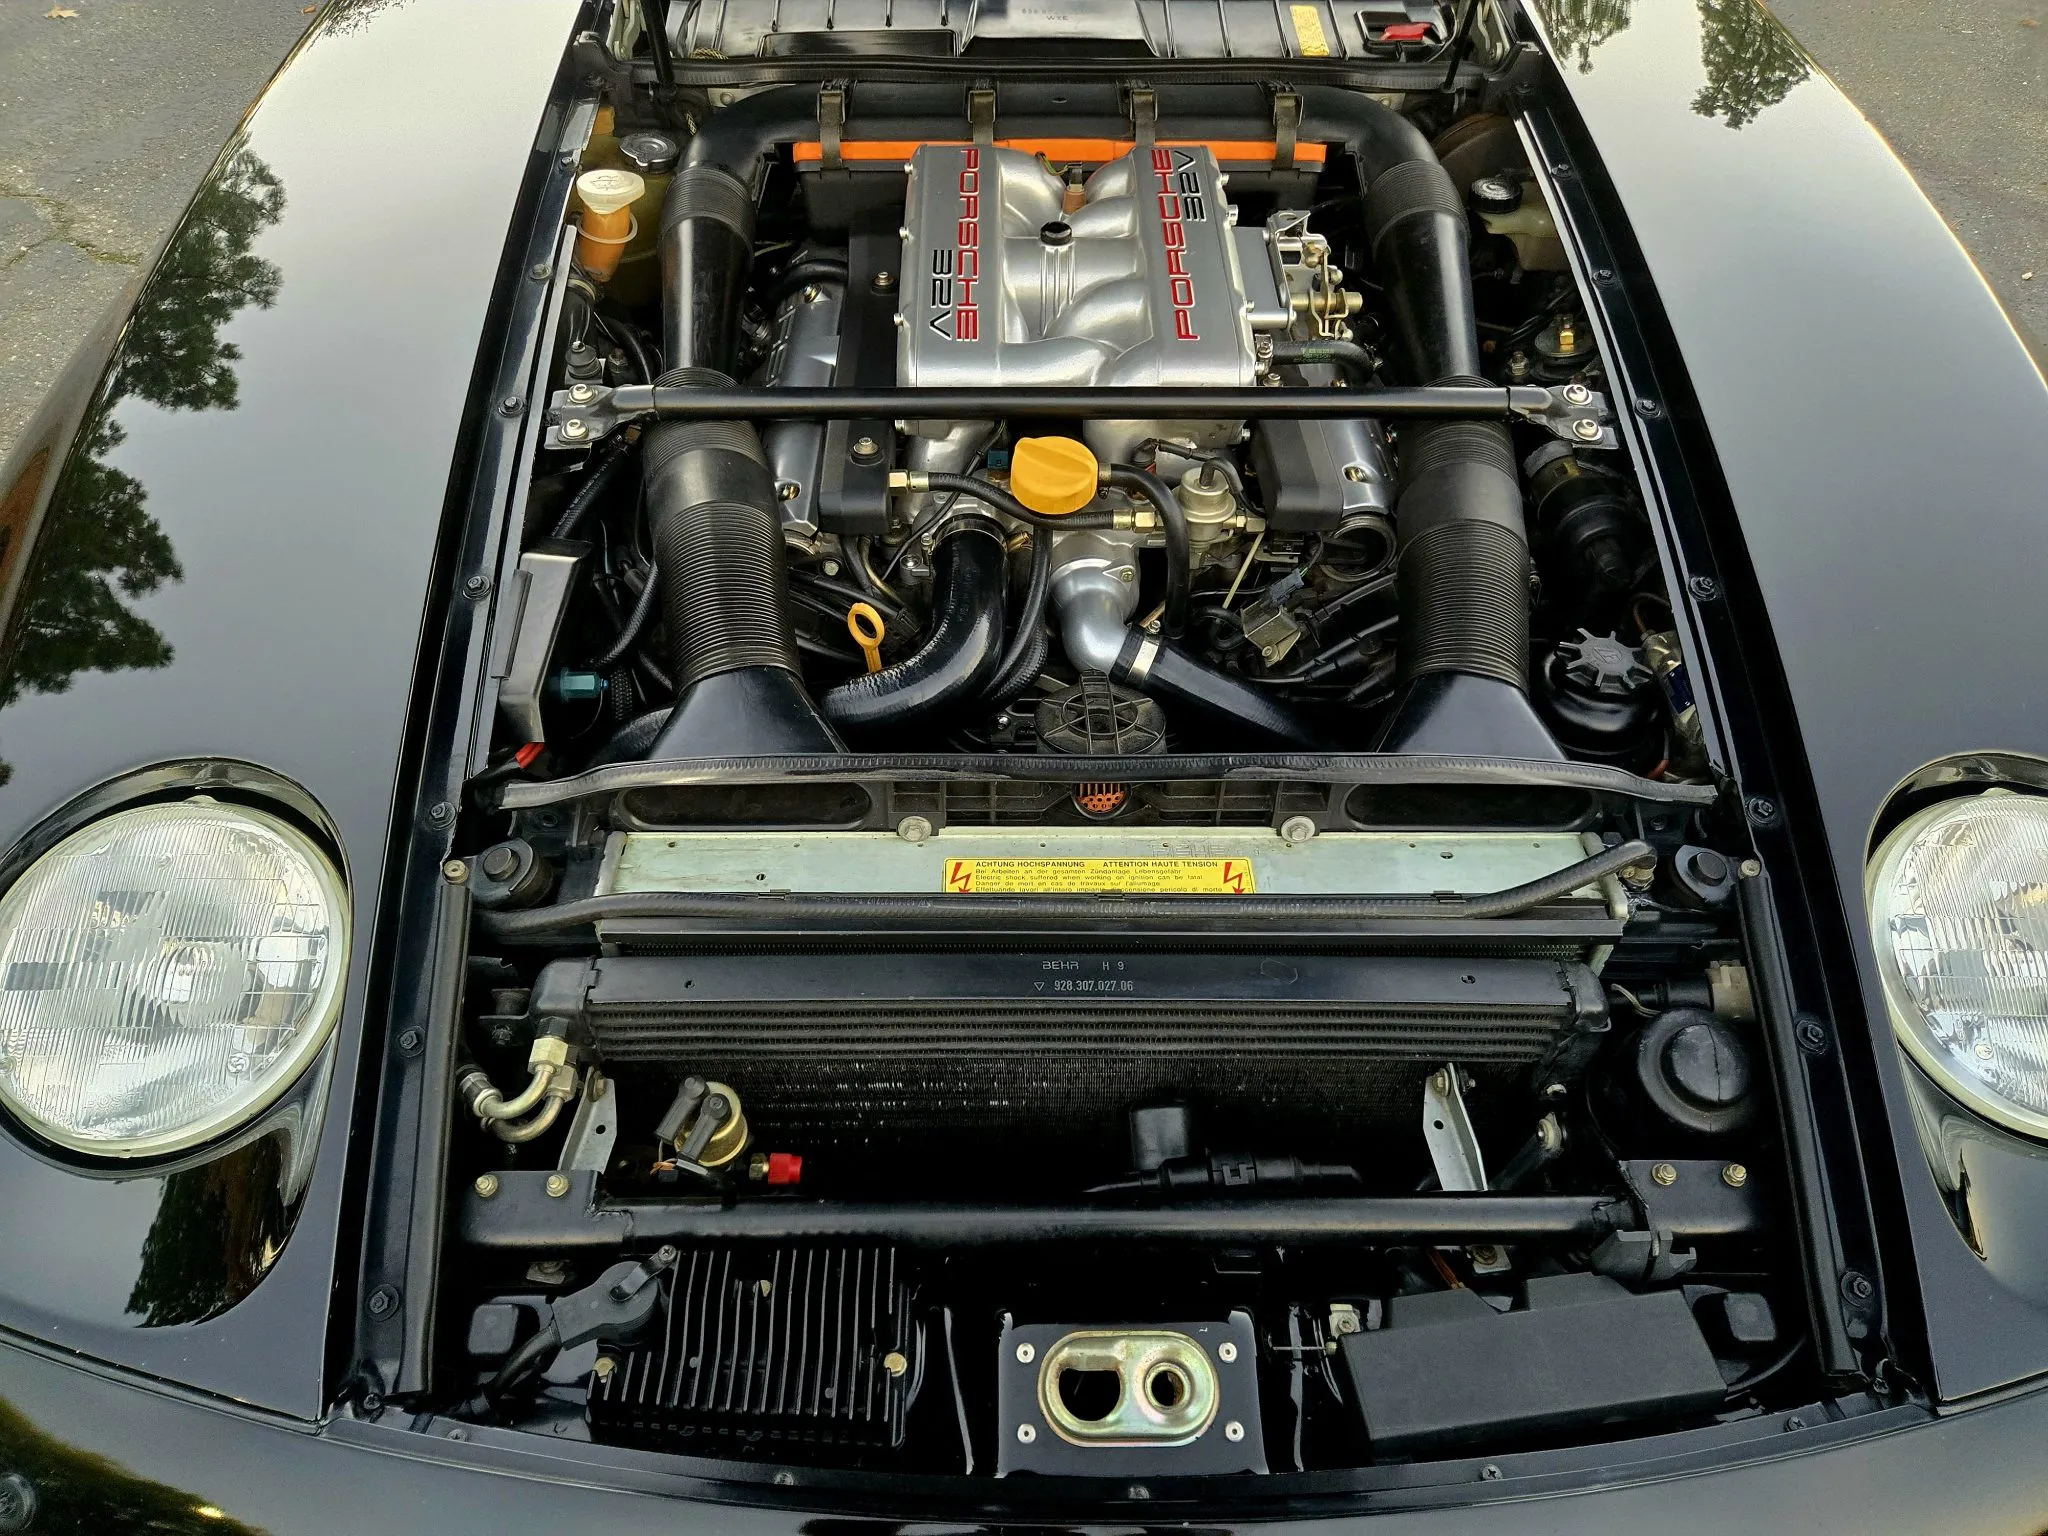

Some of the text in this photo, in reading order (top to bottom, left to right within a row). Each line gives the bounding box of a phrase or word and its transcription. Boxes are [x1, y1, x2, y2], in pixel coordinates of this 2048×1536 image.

[1174, 150, 1206, 222] 32V
[956, 148, 979, 342] PORSCHE
[1151, 149, 1200, 341] PORSCHE
[929, 249, 952, 341] 32V
[1084, 874, 1112, 882] working
[1128, 874, 1154, 882] ignition
[1089, 868, 1131, 876] Zündanlage
[1042, 961, 1124, 970] BEHR H 9
[1054, 981, 1134, 991] 928.307.027.06
